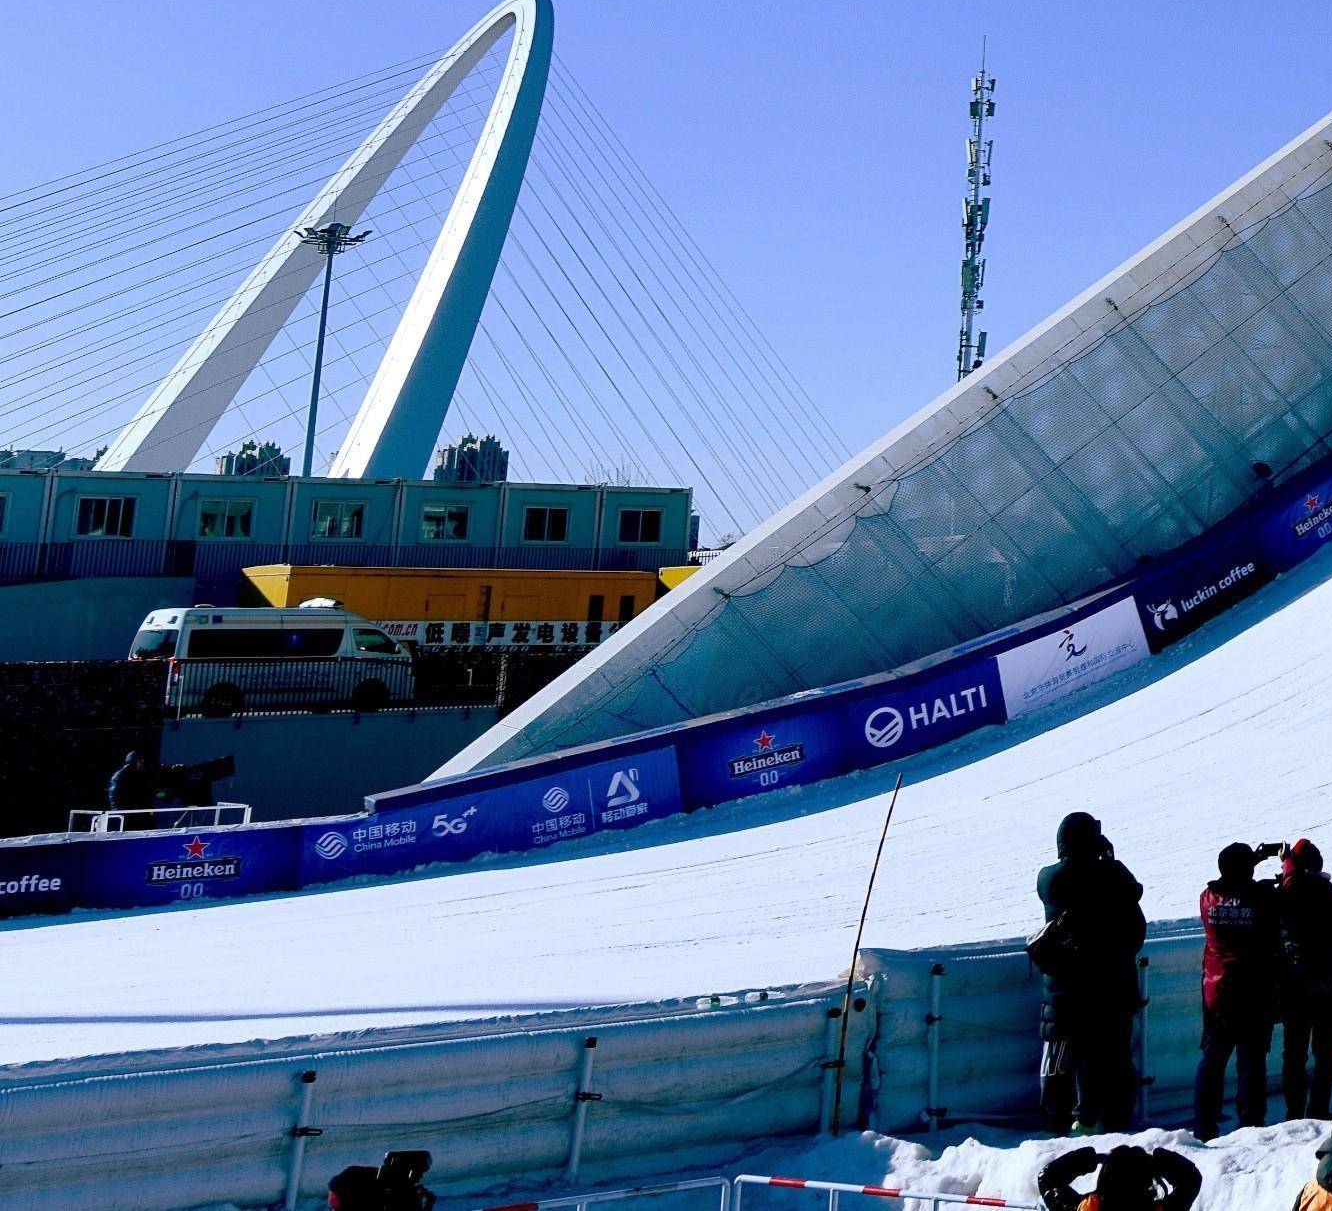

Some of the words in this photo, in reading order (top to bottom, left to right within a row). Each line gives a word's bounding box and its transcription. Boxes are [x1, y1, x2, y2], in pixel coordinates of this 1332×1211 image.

[1180, 586, 1218, 612] luckin
[1218, 562, 1255, 590] coffee
[908, 685, 987, 730] HALTI
[733, 749, 801, 776] Heineken
[353, 820, 417, 843] 中国移动
[532, 812, 586, 835] 中国移动
[353, 841, 382, 853] China
[384, 835, 417, 848] Mobile
[533, 834, 558, 845] China
[559, 826, 586, 839] Mobile
[151, 863, 236, 881] Heineken
[0, 874, 62, 895] coffee
